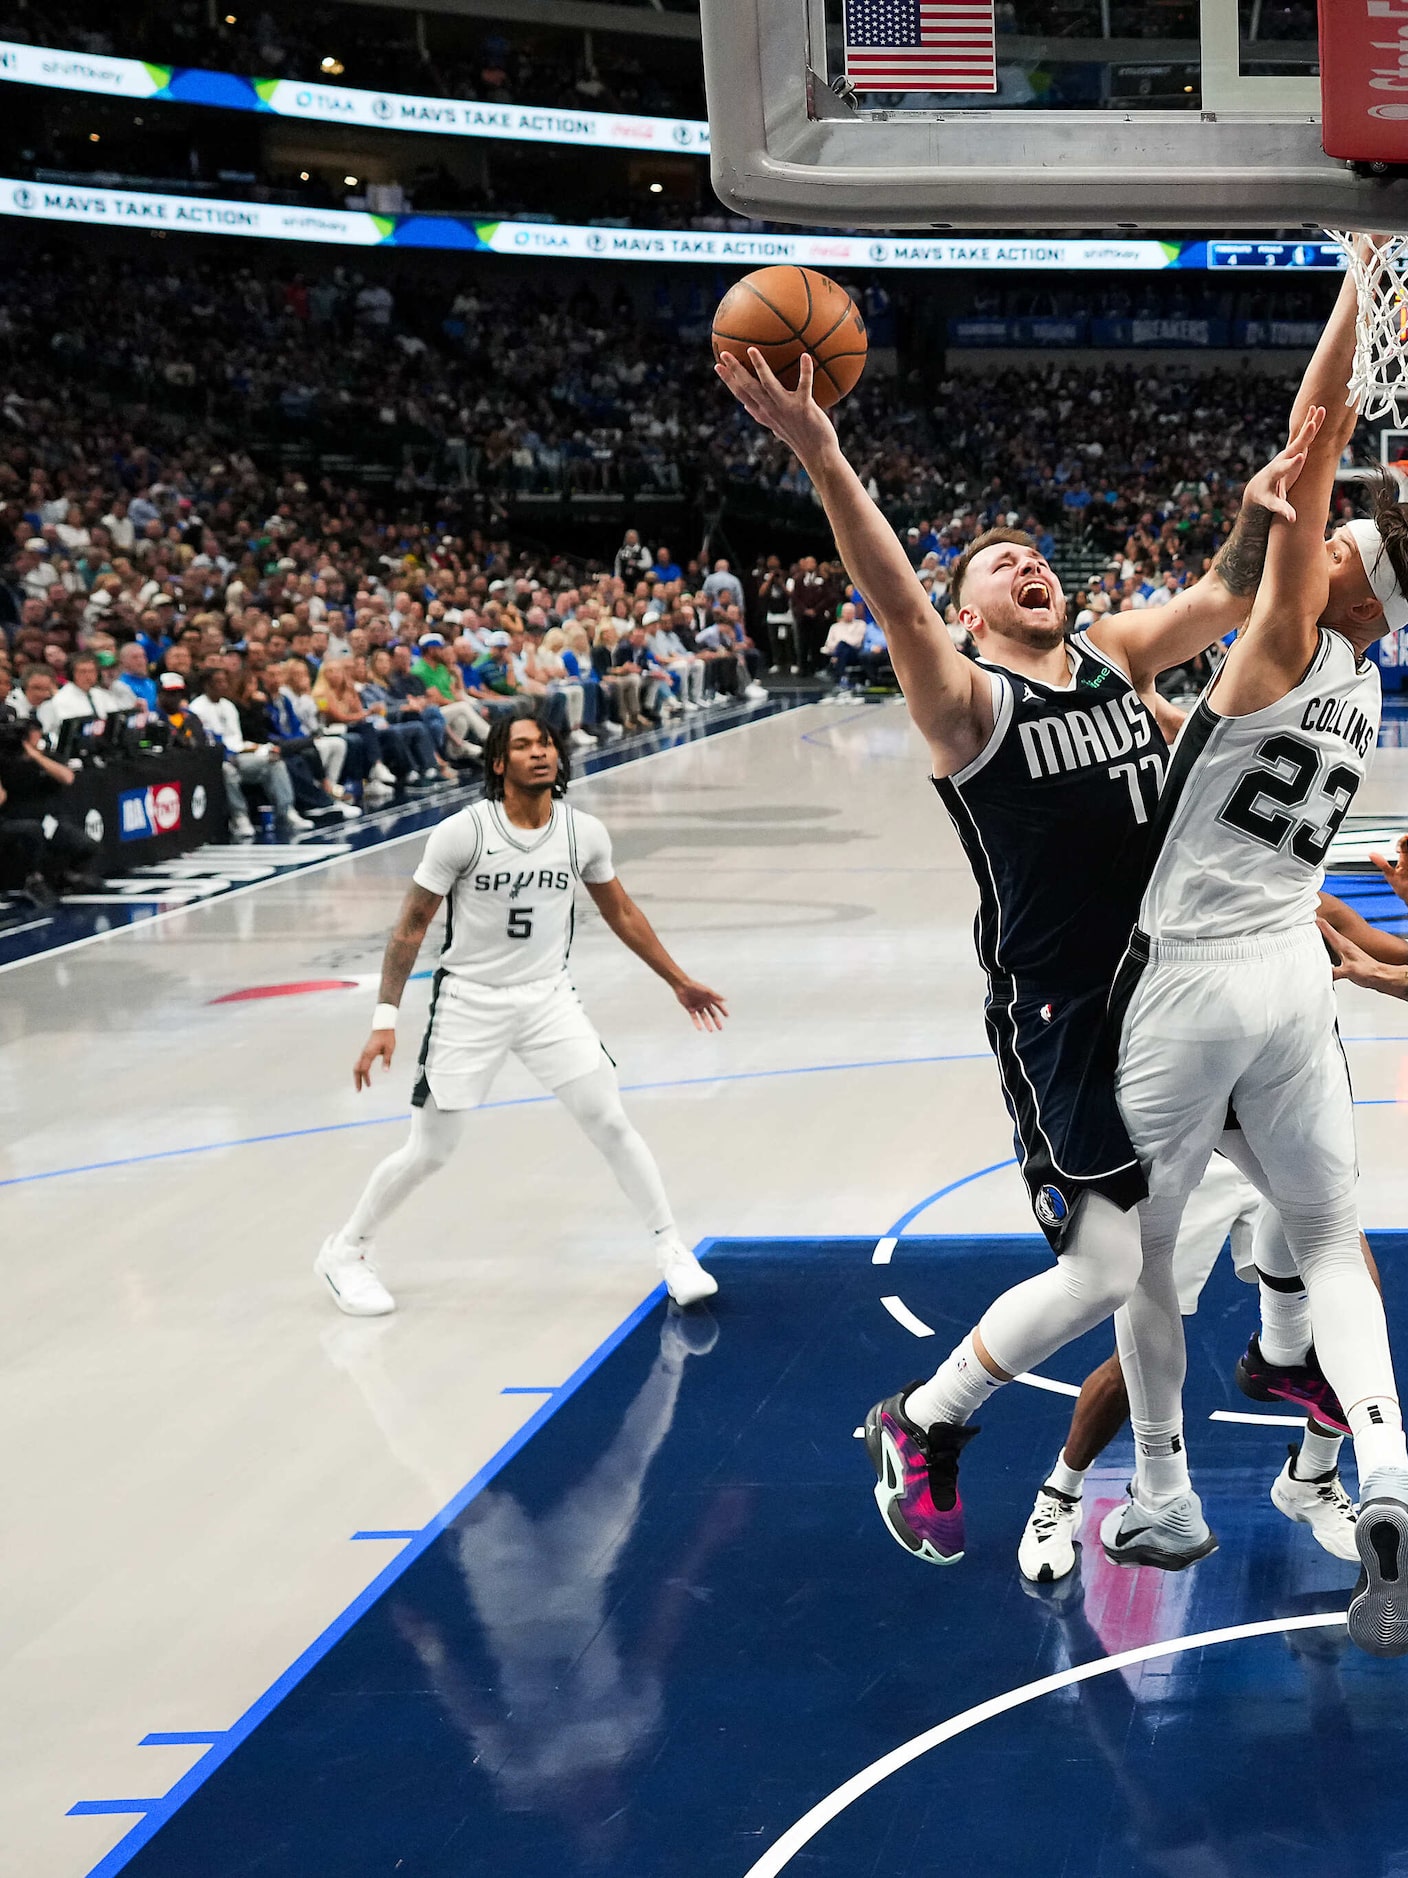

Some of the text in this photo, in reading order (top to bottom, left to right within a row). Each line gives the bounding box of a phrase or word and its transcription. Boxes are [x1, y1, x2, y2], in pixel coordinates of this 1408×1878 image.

[401, 105, 456, 123] MAVS
[464, 110, 511, 128] TAKE
[519, 115, 597, 135] ACTION!
[44, 194, 259, 226] MAVS TAKE ACTION!
[534, 233, 569, 247] TIAA
[613, 238, 665, 251] MAVS
[671, 239, 713, 253] TAKE
[722, 241, 795, 257] ACTION!
[894, 247, 1066, 261] MAVS TAKE ACTION!
[1081, 667, 1110, 689] ime
[1018, 690, 1150, 779] MAVS
[1300, 697, 1374, 759] COLLINS
[1108, 753, 1165, 824] 77
[1214, 731, 1364, 872] 23
[475, 870, 570, 899] SPURS
[507, 907, 533, 938] 5
